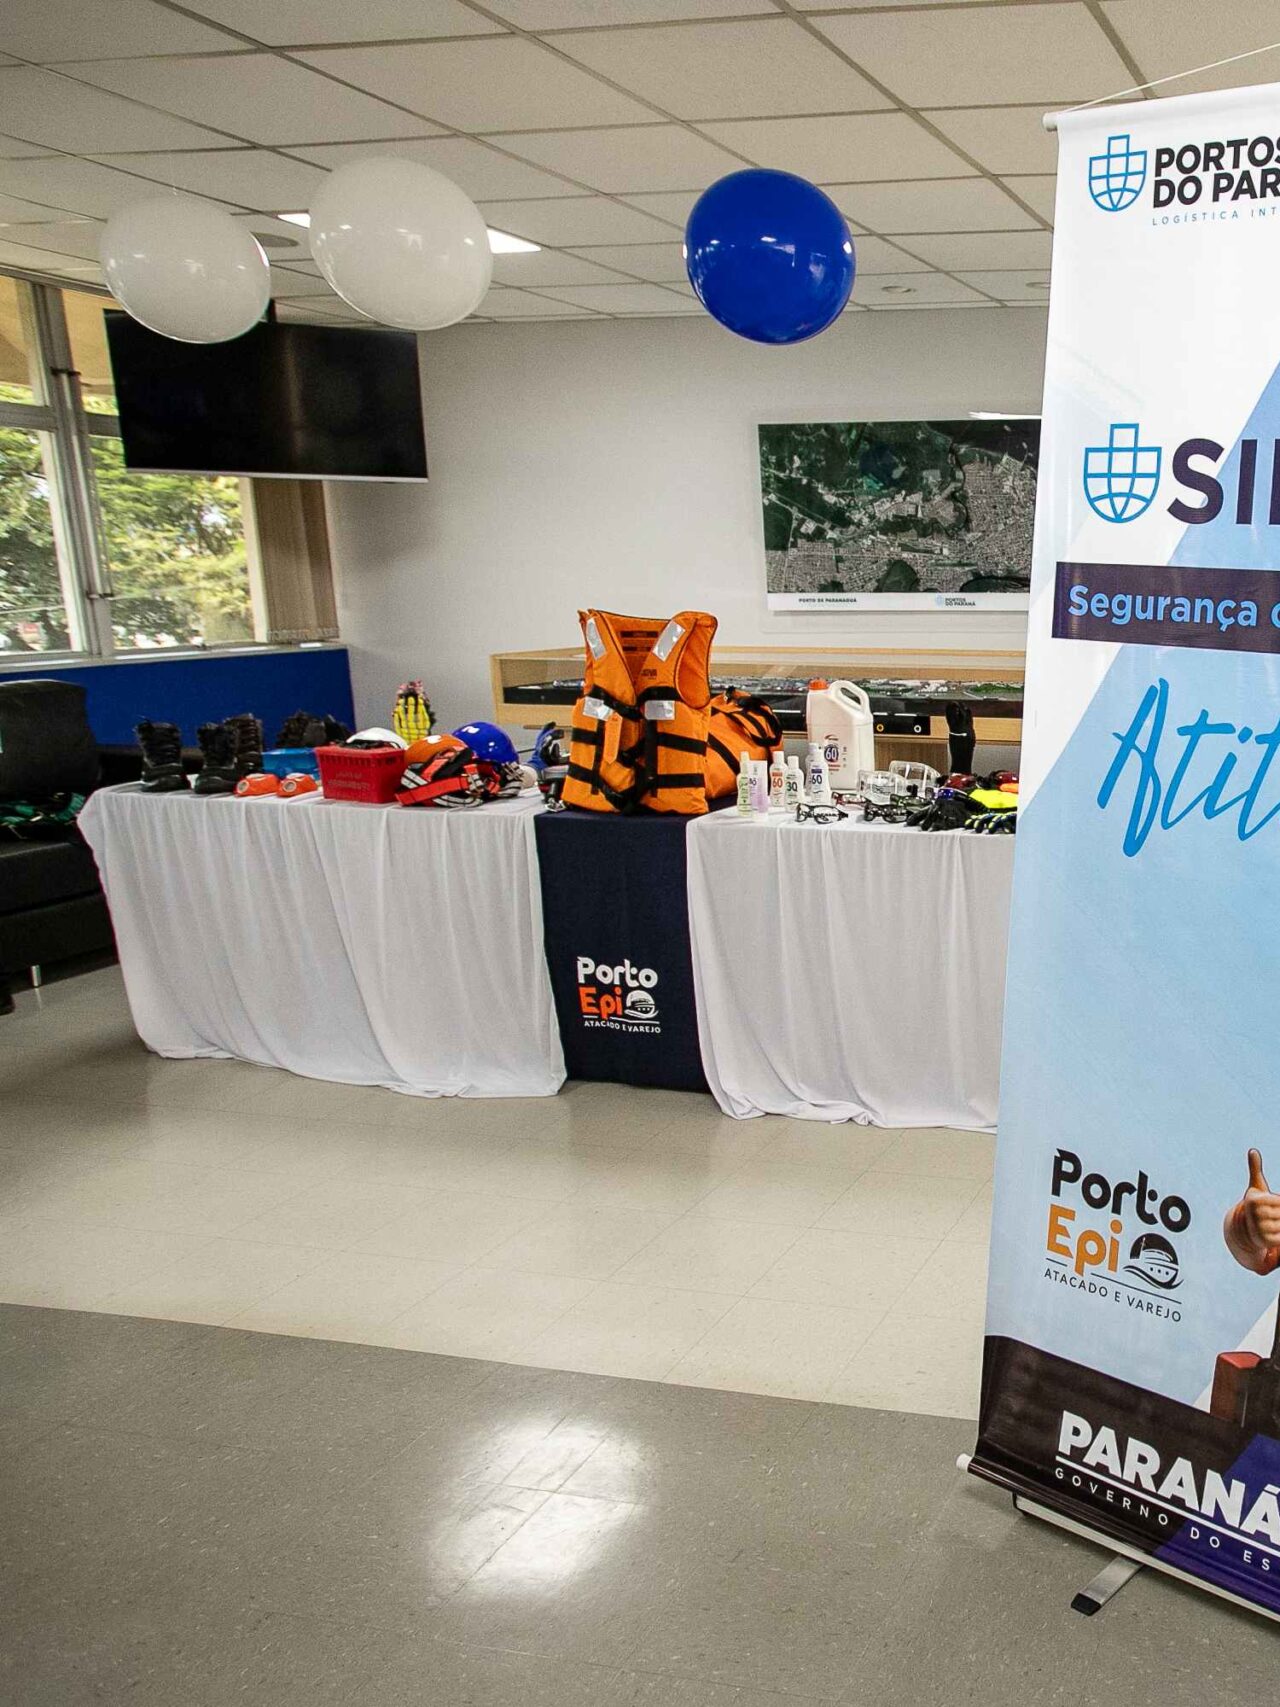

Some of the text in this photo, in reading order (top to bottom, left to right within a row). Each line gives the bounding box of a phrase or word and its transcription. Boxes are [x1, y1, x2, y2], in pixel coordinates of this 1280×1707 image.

[1153, 176, 1205, 208] DO
[1152, 209, 1240, 226] LOGÍSTICA
[1068, 585, 1258, 631] Segurança
[825, 748, 837, 760] 60
[772, 777, 783, 788] 60
[811, 774, 822, 785] 60
[577, 956, 658, 988] Porto
[578, 986, 623, 1020] Epi
[584, 1020, 620, 1031] ATACADO
[628, 1025, 661, 1034] VAREJO
[1051, 1148, 1191, 1233] Porto
[1046, 1204, 1123, 1277] Epi
[1043, 1269, 1182, 1323] ATACADO E VAREJO
[1055, 1467, 1168, 1527] GOVERNO
[1190, 1527, 1221, 1549] DO
